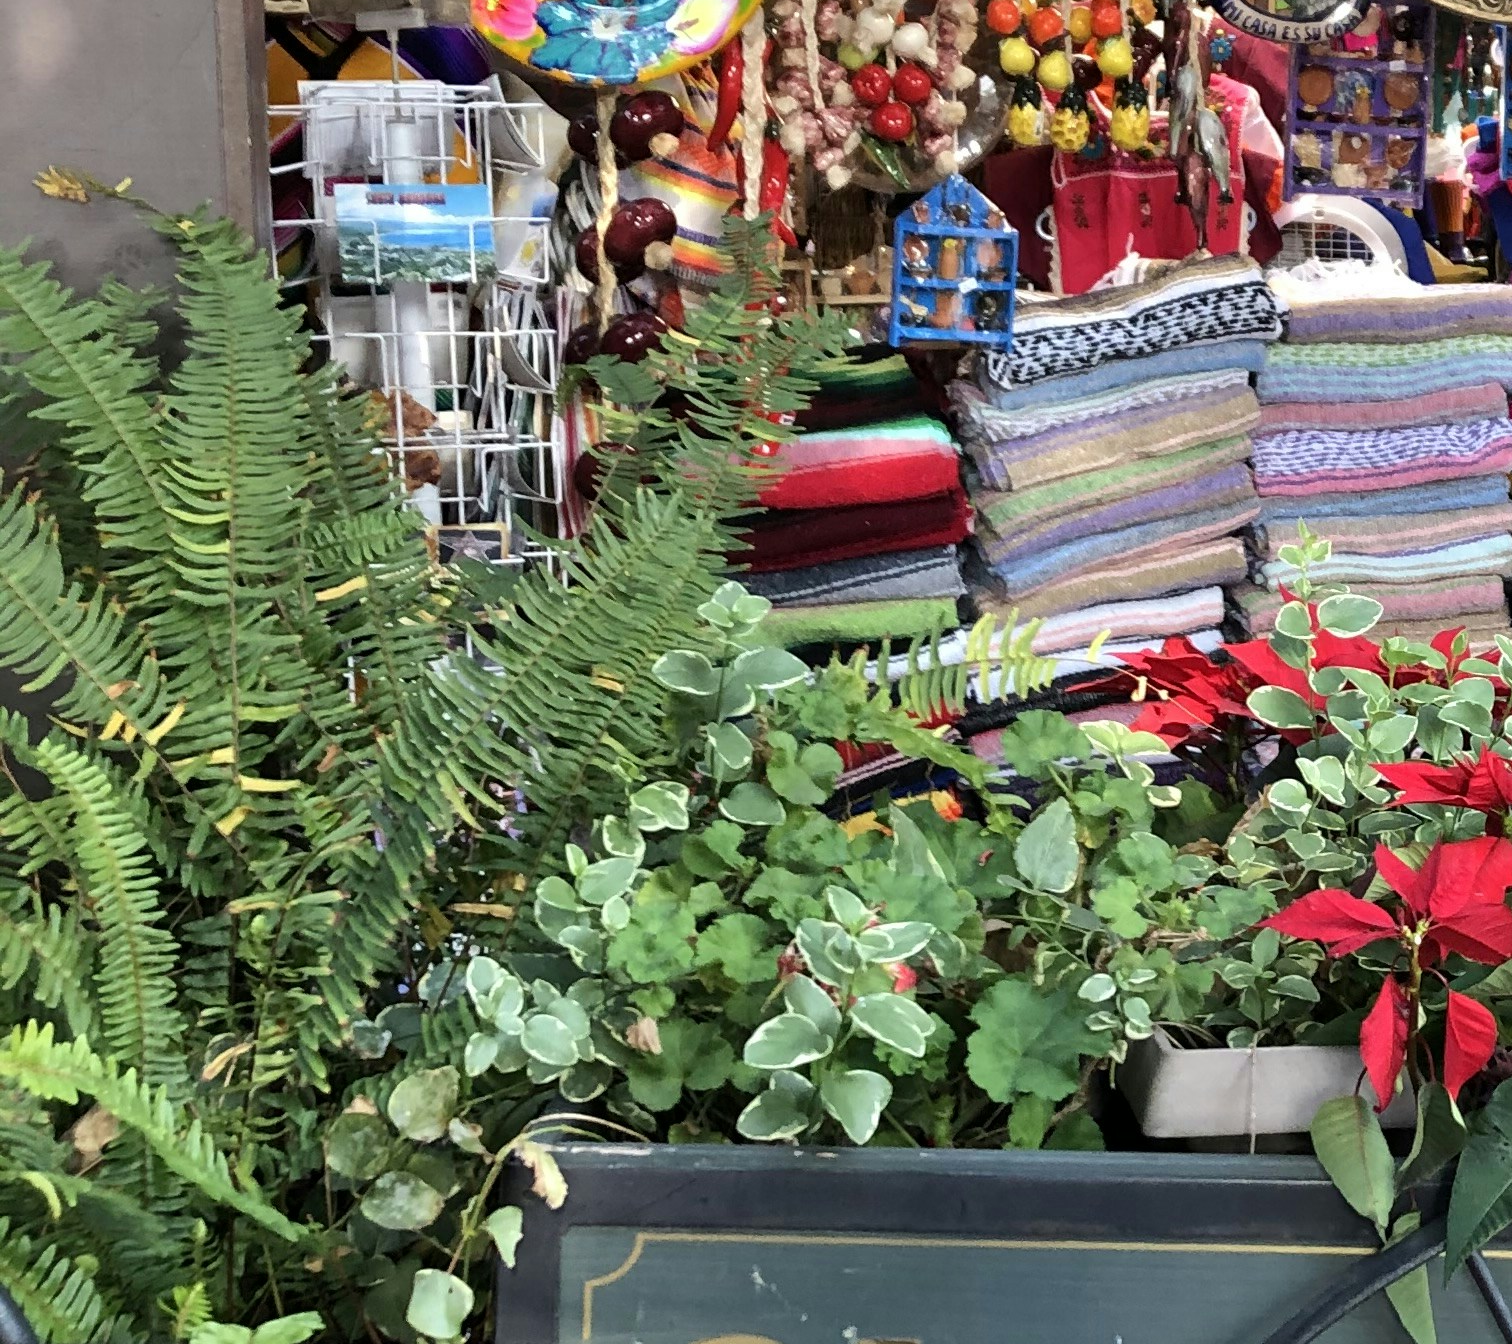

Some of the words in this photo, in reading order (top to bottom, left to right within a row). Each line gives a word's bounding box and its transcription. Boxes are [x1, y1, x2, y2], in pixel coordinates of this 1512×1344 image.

[1223, 1, 1241, 22] MI
[1242, 16, 1277, 38] CASA
[1282, 25, 1300, 41] ES
[1304, 26, 1322, 41] SU
